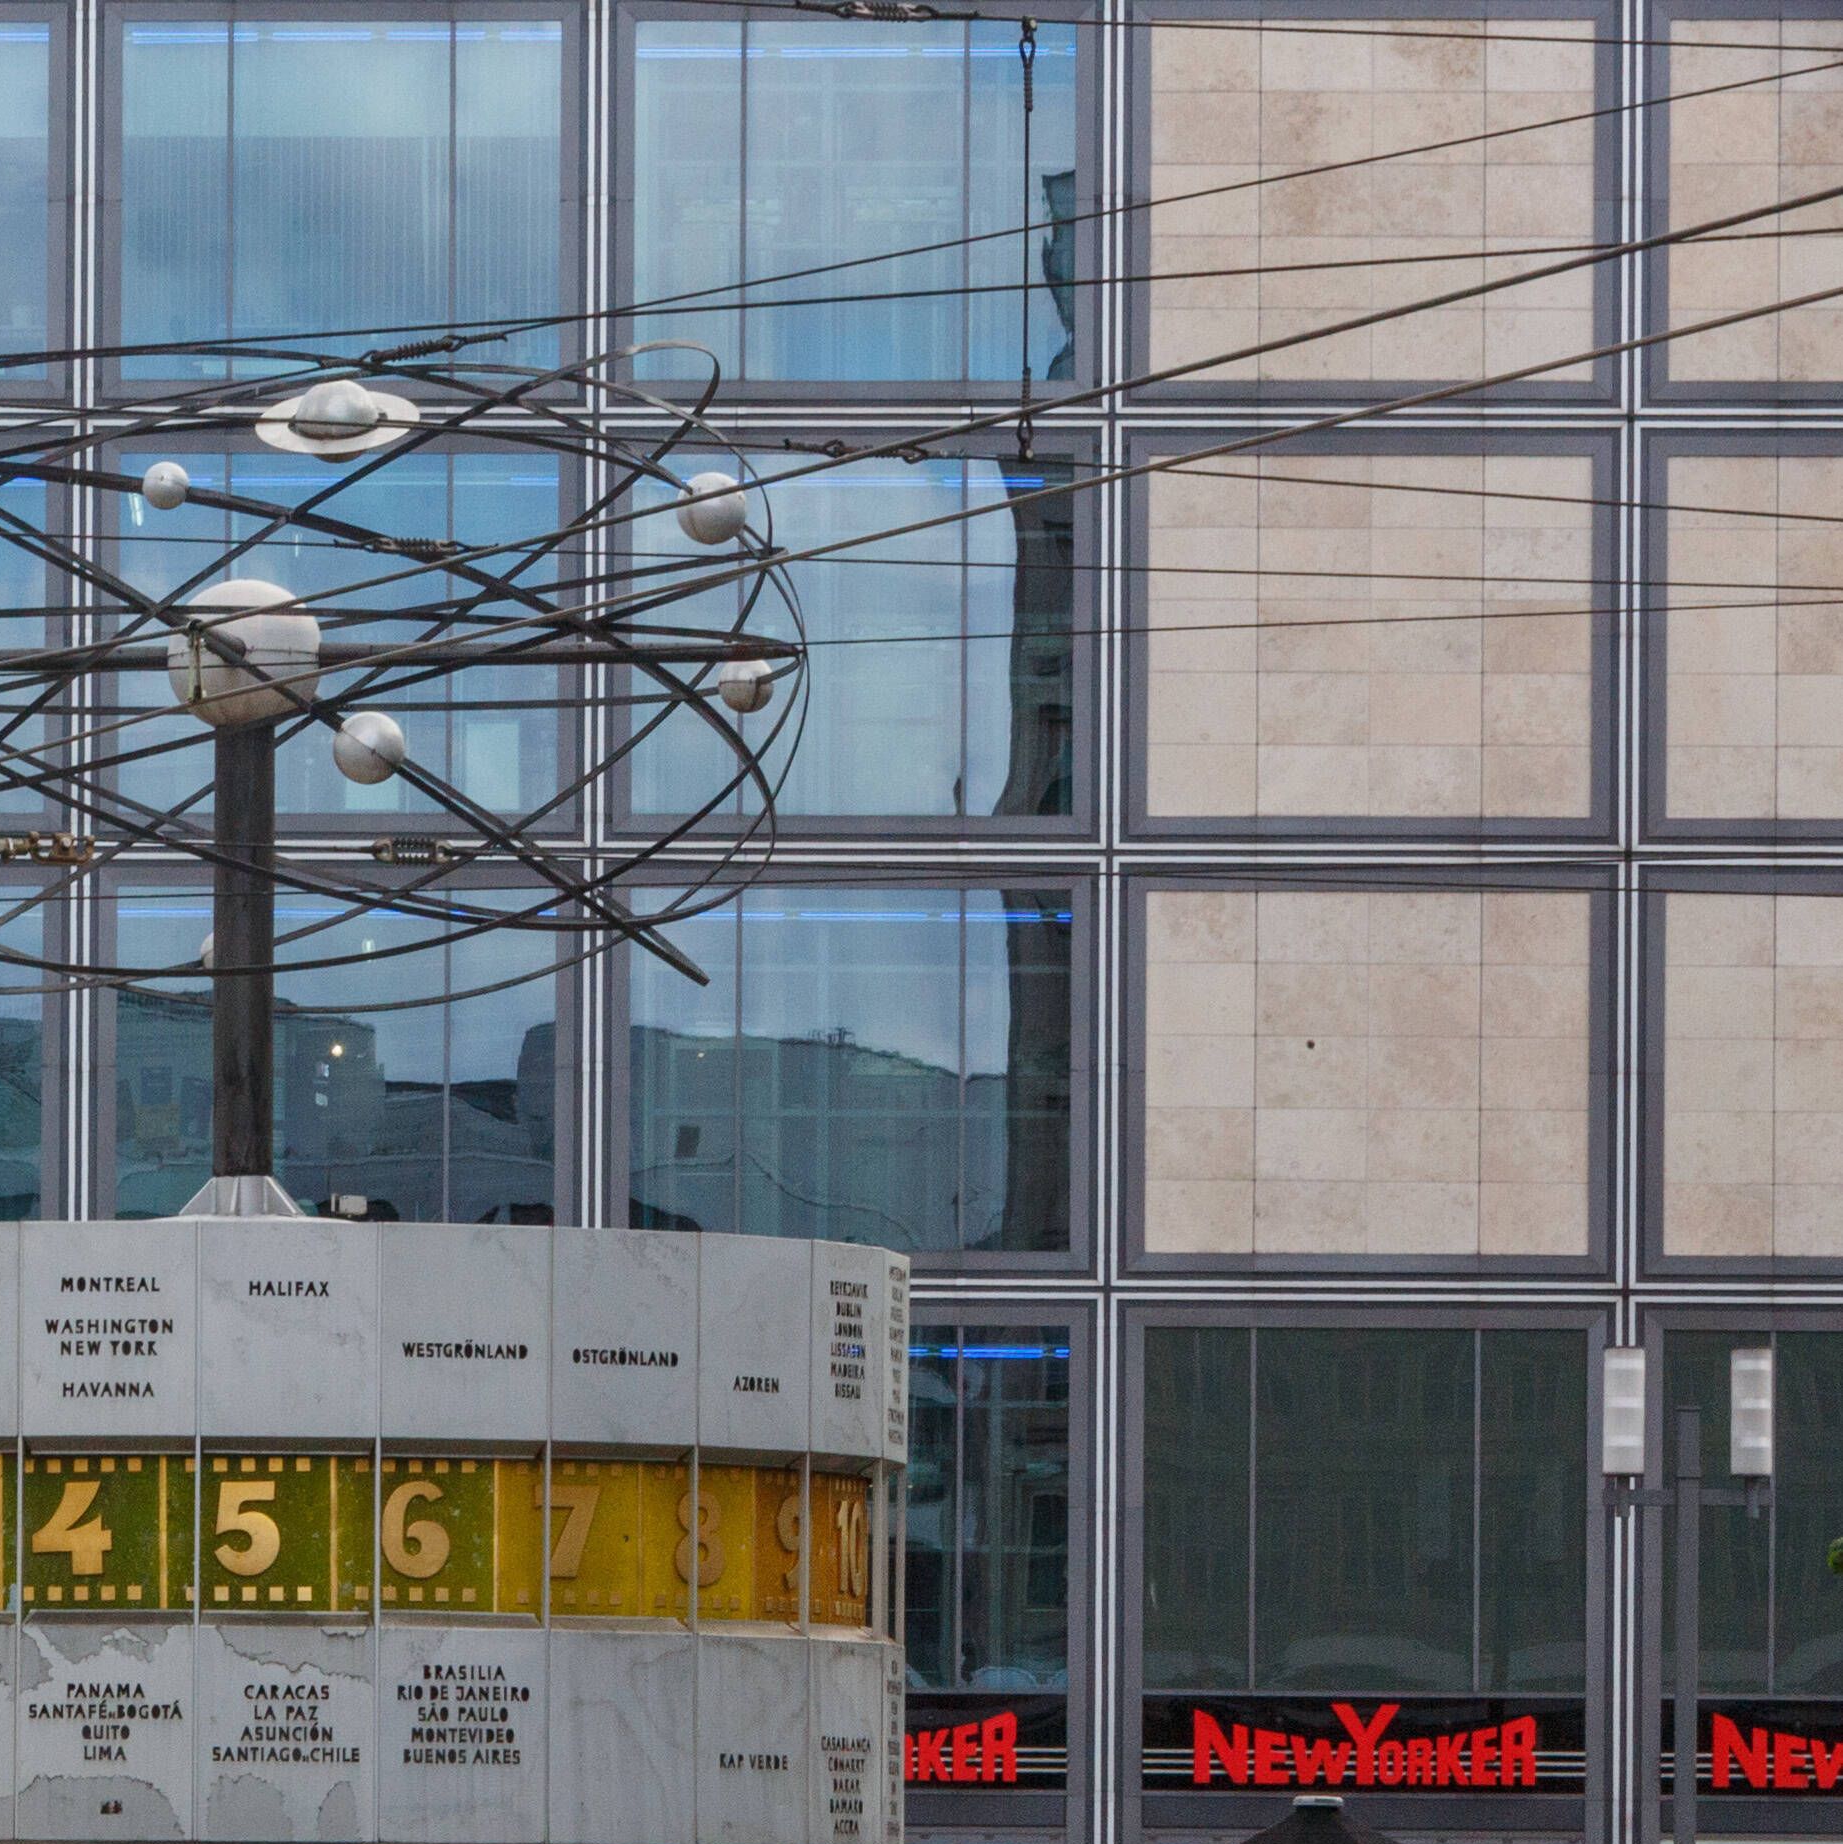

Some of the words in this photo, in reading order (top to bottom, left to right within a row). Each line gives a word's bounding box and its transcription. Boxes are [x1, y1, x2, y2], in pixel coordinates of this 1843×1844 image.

[61, 1276, 160, 1293] MONTREAL
[249, 1280, 329, 1298] HALIFAX
[830, 1280, 868, 1299] REYKJAVIK
[836, 1301, 862, 1318] DUBLIN
[45, 1318, 173, 1334] WASHINGTON
[834, 1322, 863, 1339] LONDON
[61, 1340, 101, 1356] NEW
[109, 1340, 157, 1356] YORK
[402, 1339, 528, 1360] WESTGRÖNLAND
[573, 1347, 678, 1367] OSTGRÖNLAND
[831, 1342, 865, 1360] LISSABON
[831, 1362, 865, 1380] MADEIRA
[63, 1382, 154, 1398] HAVANNA
[733, 1376, 779, 1393] AZOREN
[835, 1383, 860, 1400] BISSAU
[32, 1481, 112, 1575] 4
[214, 1481, 280, 1576] 5
[381, 1480, 451, 1578] 6
[534, 1485, 600, 1579] 7
[675, 1489, 726, 1587] 8
[836, 1499, 866, 1598] 10
[423, 1664, 505, 1681] BRASILIA
[67, 1683, 145, 1701] PANAMA
[244, 1684, 329, 1701] CARACAS
[397, 1685, 423, 1701] RIO
[430, 1685, 449, 1704] DE
[456, 1685, 530, 1702] JANEIRO
[116, 1700, 183, 1720] BOGOTÁ
[254, 1705, 276, 1722] LA
[286, 1705, 318, 1723] PAZ
[418, 1702, 449, 1722] SÃO
[458, 1707, 508, 1722] PAULO
[82, 1725, 130, 1740] QUITO
[241, 1718, 333, 1742] ASUNCIÓN
[411, 1727, 514, 1744] MONTEVIDEO
[84, 1745, 127, 1762] LIMA
[821, 1736, 870, 1753] CASABLANCA
[310, 1747, 360, 1763] CHILE
[404, 1748, 466, 1764] BUENOS
[472, 1748, 520, 1765] AIRES
[720, 1753, 744, 1770] KAP
[749, 1754, 788, 1770] VERDE
[833, 1778, 860, 1794] DAKAR
[830, 1798, 863, 1816] BAMAKO
[834, 1819, 859, 1837] ACCRA
